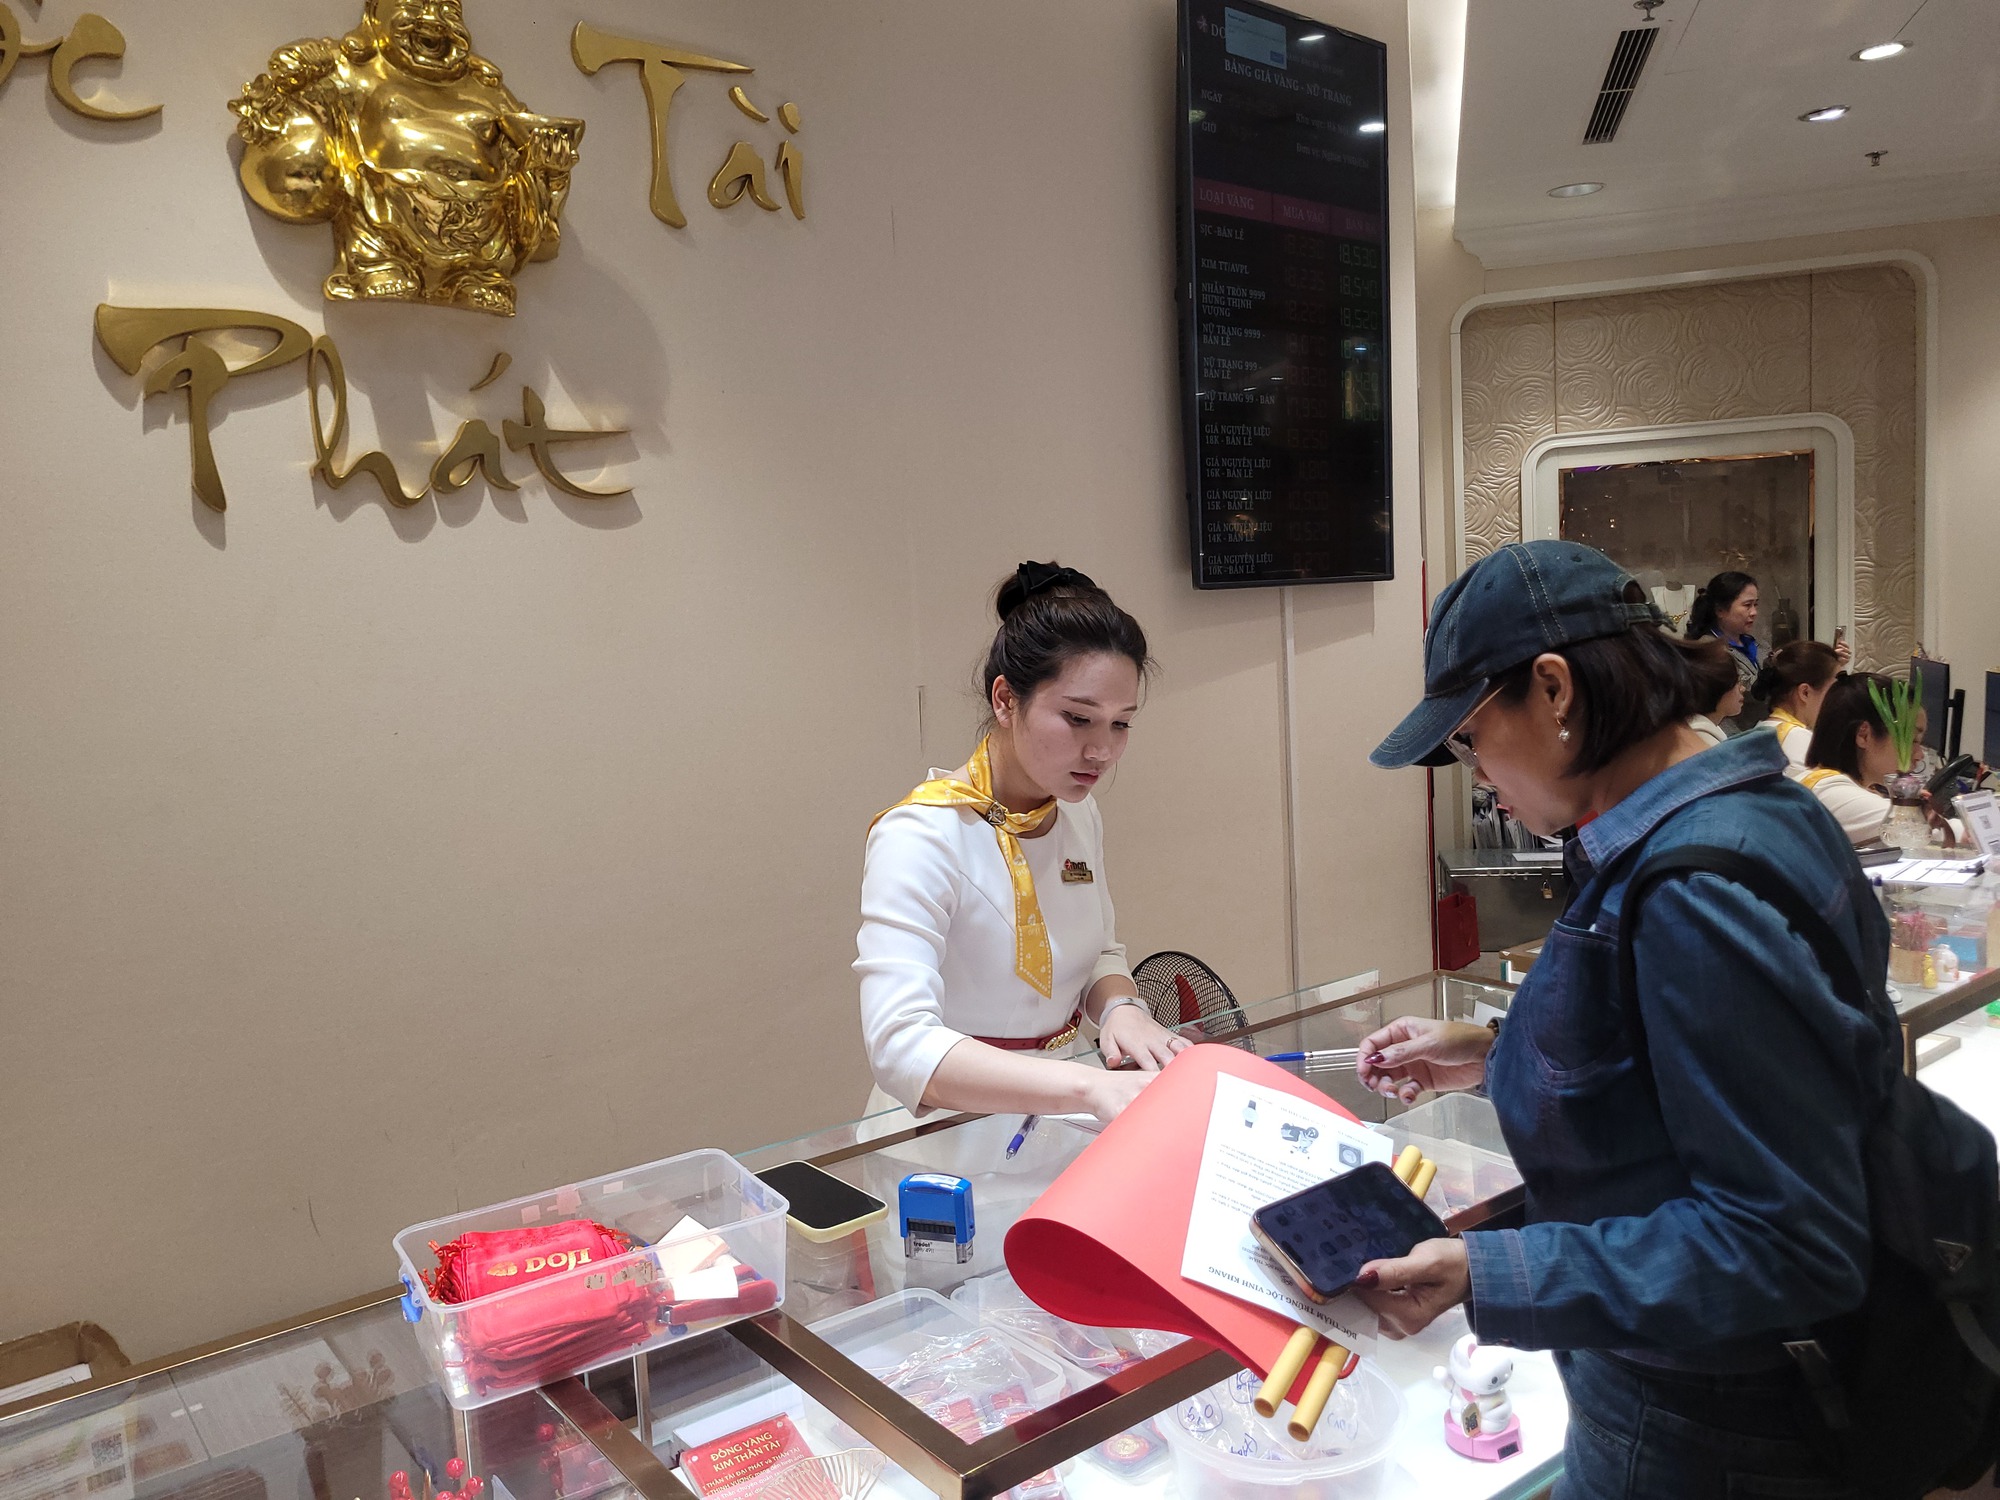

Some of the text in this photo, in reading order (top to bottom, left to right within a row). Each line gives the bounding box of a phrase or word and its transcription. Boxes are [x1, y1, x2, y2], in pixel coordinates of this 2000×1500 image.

[1255, 66, 1272, 83] GIÁ
[1273, 71, 1299, 92] VÀNG
[1322, 87, 1352, 106] TRANG
[572, 20, 806, 229] Tài
[1201, 257, 1217, 270] KIM
[1218, 391, 1244, 403] TRANG
[95, 304, 632, 513] Phát
[1206, 435, 1219, 445] 18K
[1206, 468, 1220, 478] 16K
[1207, 501, 1221, 511] 15K
[1208, 533, 1222, 543] 14K
[1208, 565, 1223, 576] 10K
[525, 1247, 593, 1273] DOJI
[1208, 1265, 1241, 1285] KHANG
[1242, 1279, 1264, 1294] VINH
[1265, 1287, 1285, 1303] LỘC
[710, 1432, 773, 1462] ĐỒNG VÀNG
[713, 1440, 781, 1473] KIM THẦN TÀI
